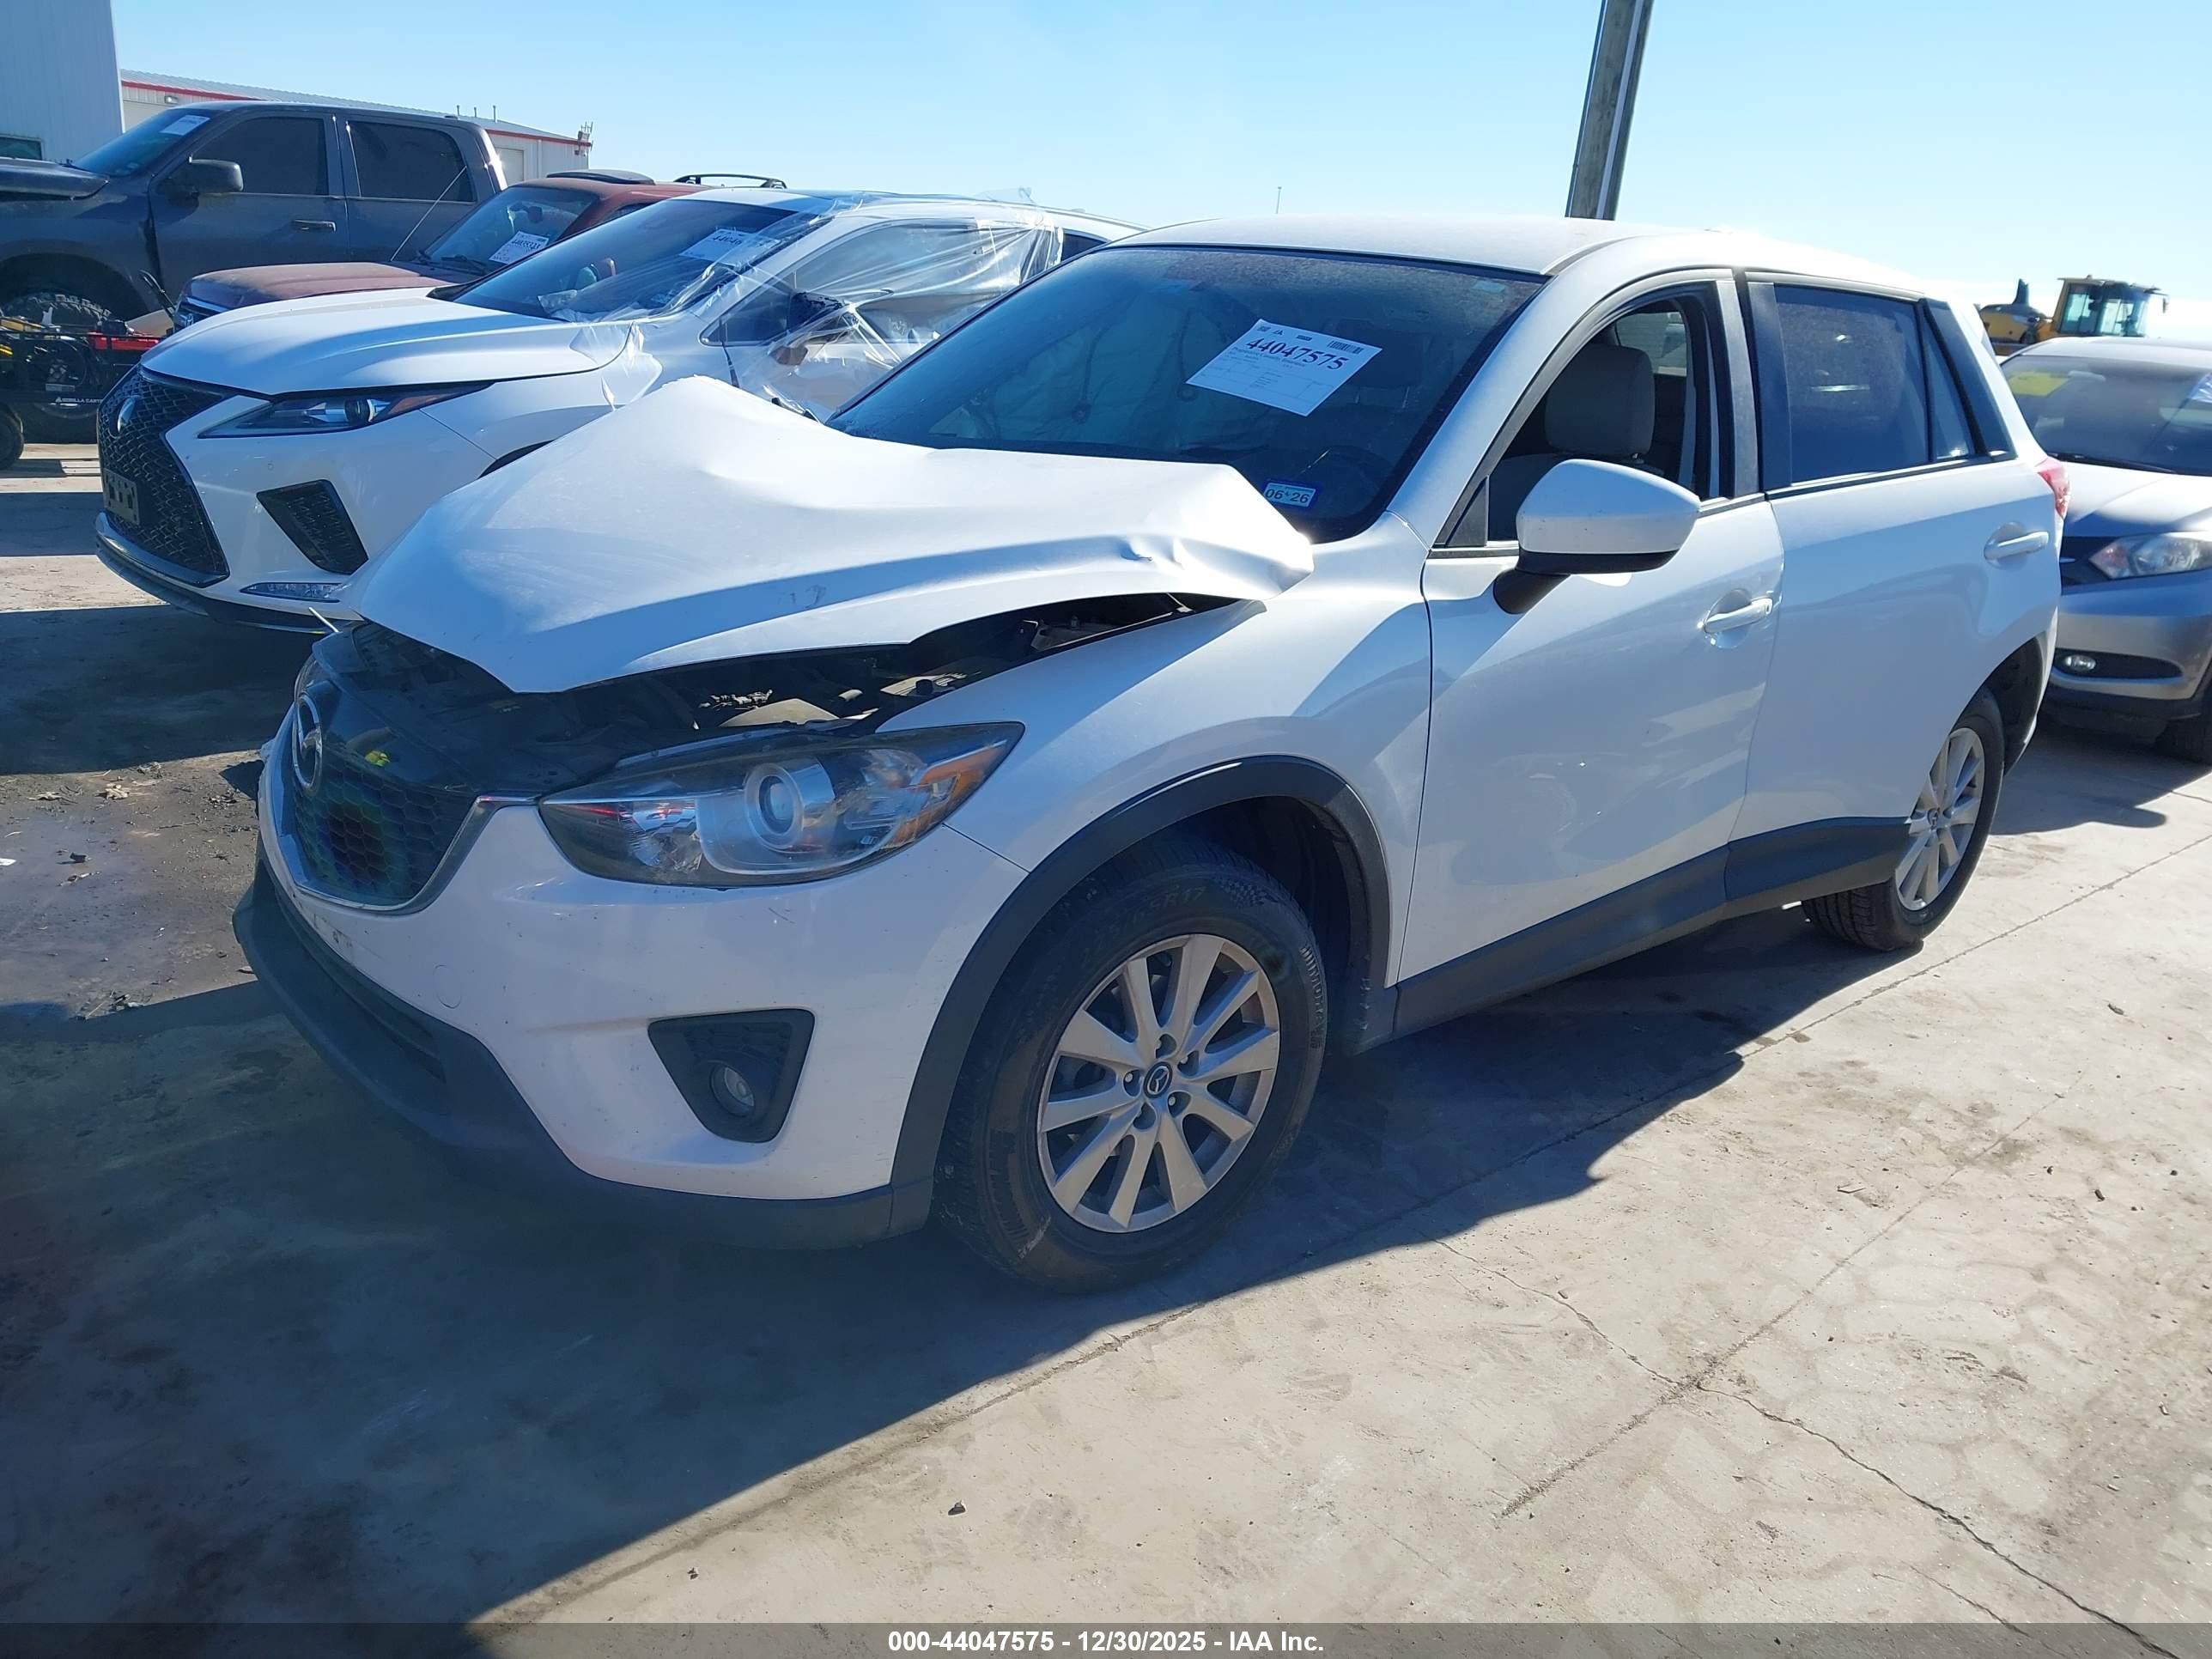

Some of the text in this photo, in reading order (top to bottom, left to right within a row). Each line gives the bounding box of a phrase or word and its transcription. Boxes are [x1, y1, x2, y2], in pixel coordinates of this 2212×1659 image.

[1245, 337, 1350, 371] 44047575
[1265, 489, 1310, 503] 06 26
